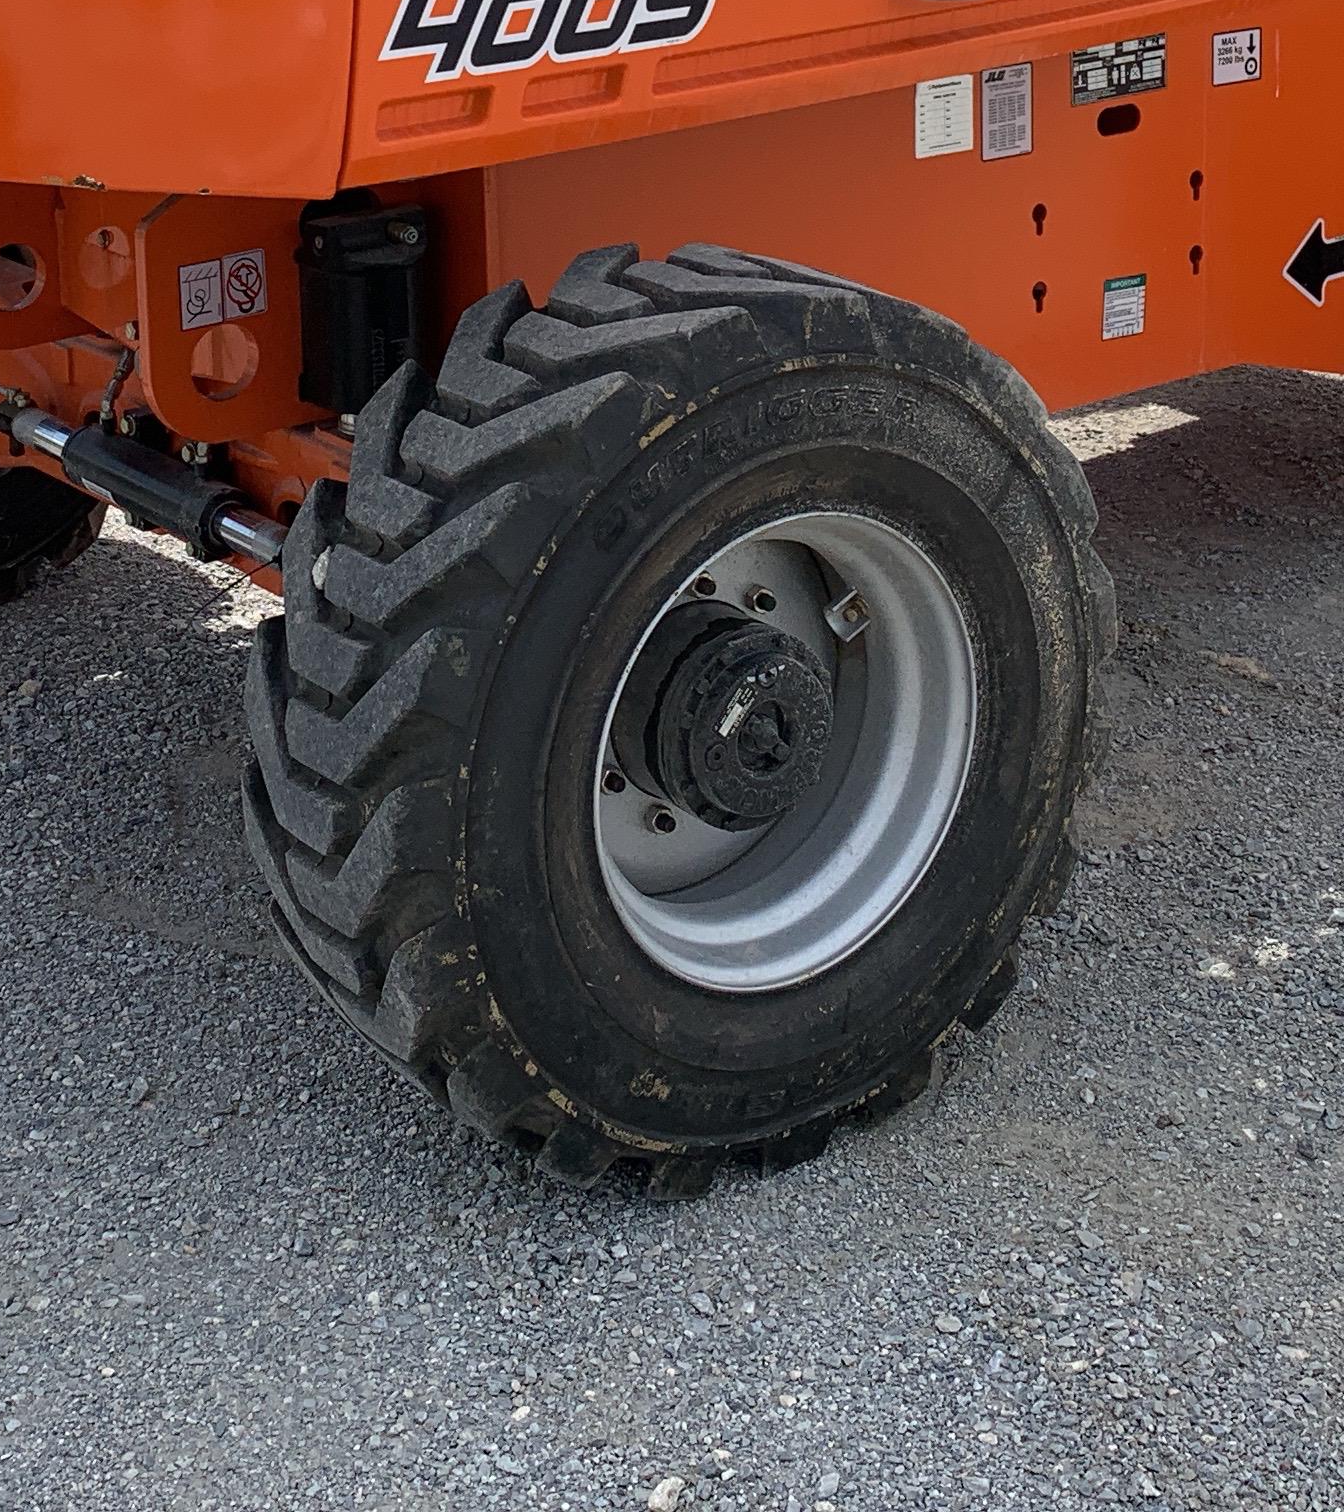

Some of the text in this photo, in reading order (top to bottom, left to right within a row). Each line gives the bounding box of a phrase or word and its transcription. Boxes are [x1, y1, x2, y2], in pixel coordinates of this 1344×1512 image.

[1221, 37, 1237, 46] MAX
[1234, 46, 1243, 56] kg
[1111, 278, 1142, 288] IMPORTANT
